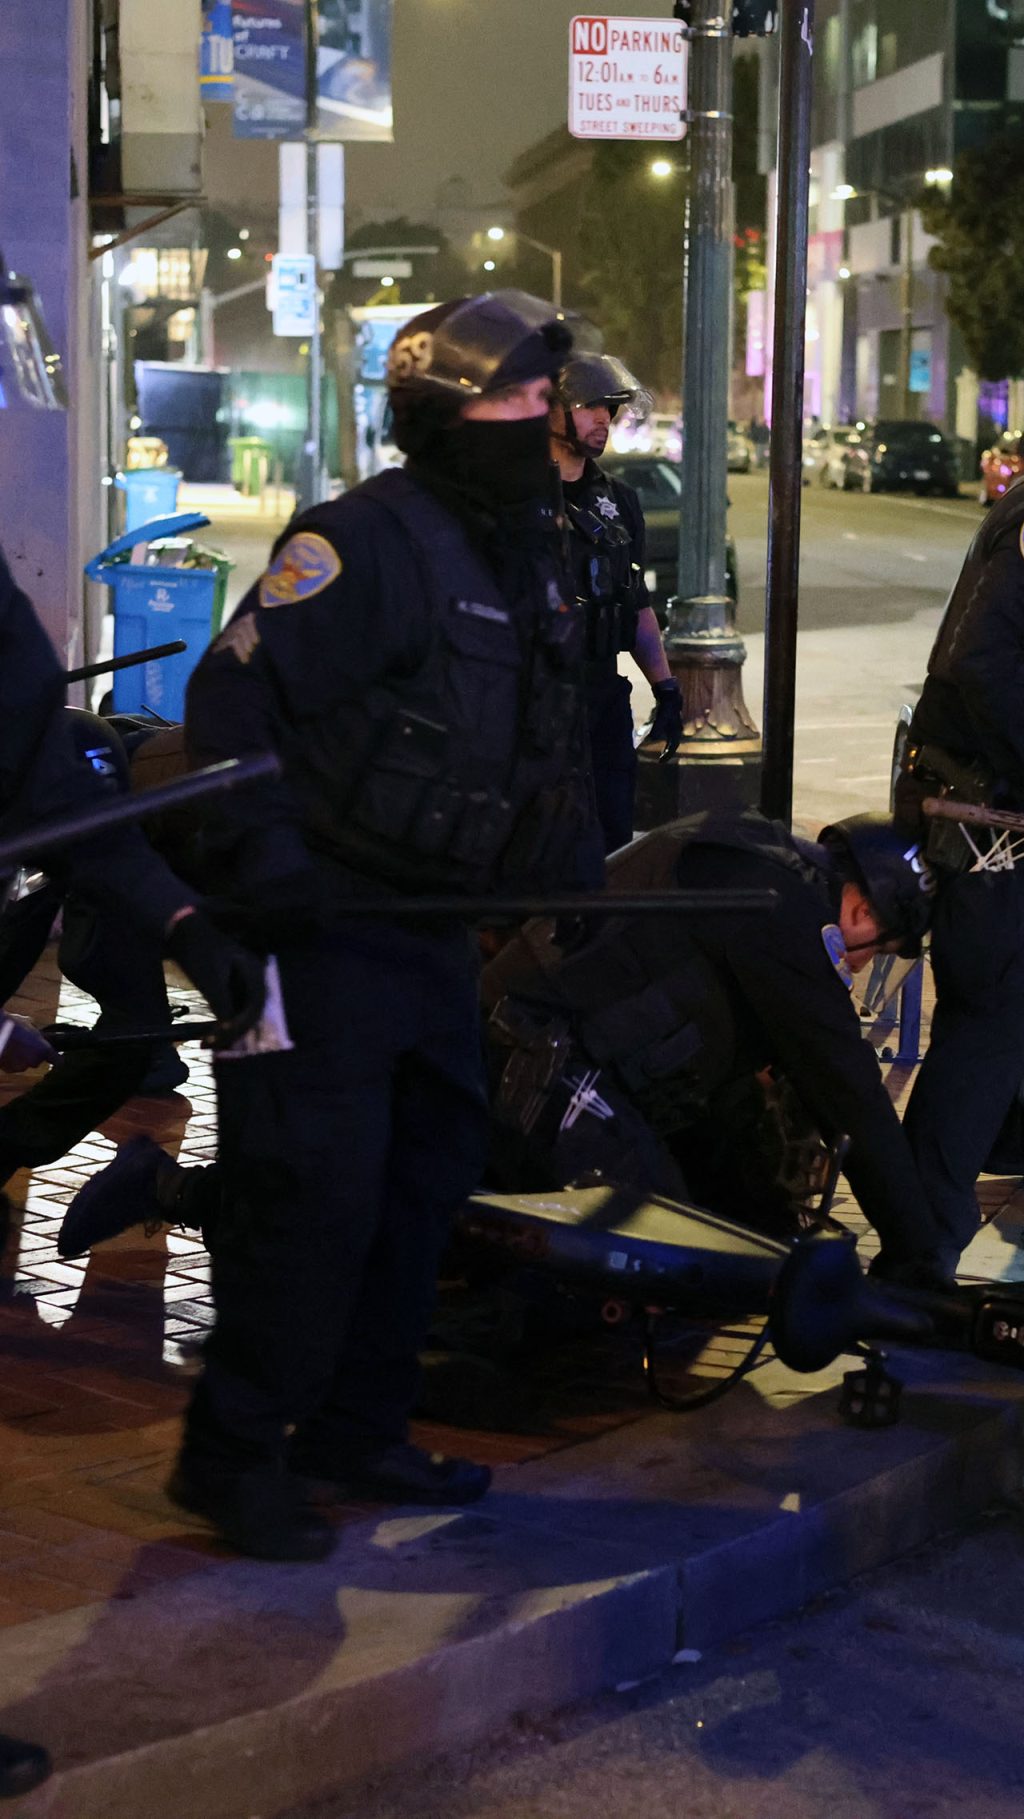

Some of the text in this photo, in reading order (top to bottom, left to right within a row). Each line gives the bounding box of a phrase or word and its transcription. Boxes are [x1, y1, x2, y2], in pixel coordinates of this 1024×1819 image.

[575, 21, 682, 53] NO PARKING
[578, 92, 612, 111] TUES
[634, 94, 681, 113] THURS
[580, 120, 677, 134] STREET SWEEPING
